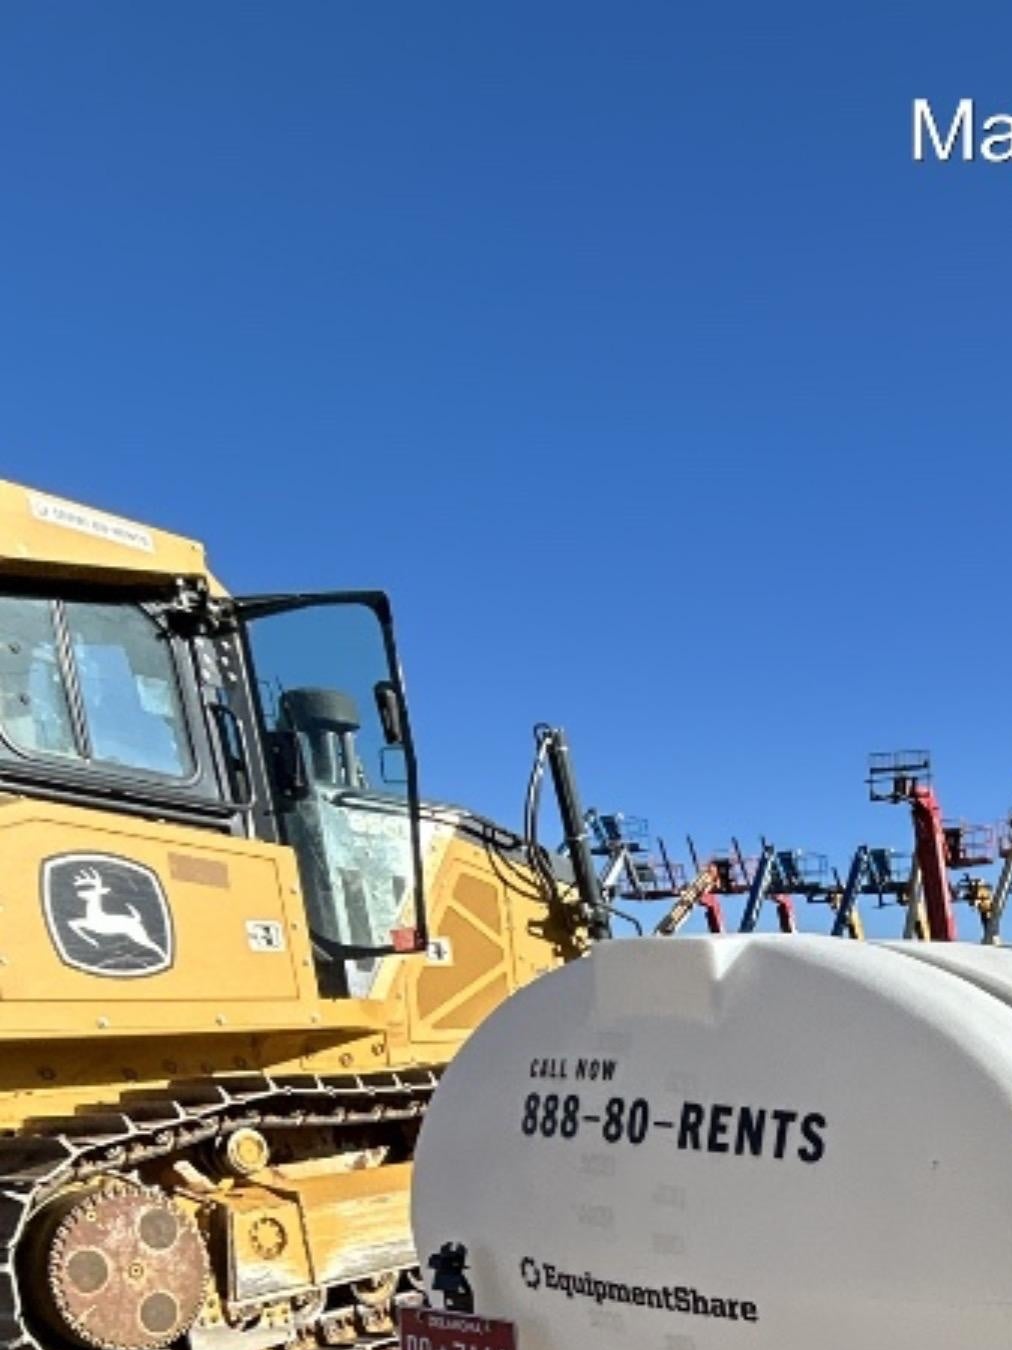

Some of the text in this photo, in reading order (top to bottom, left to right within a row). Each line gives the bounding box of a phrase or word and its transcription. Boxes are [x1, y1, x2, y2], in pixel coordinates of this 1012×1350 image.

[529, 1058, 617, 1081] CALL NOW
[521, 1092, 827, 1164] 888-80-RENTS
[542, 1262, 760, 1323] EquipmentShare
